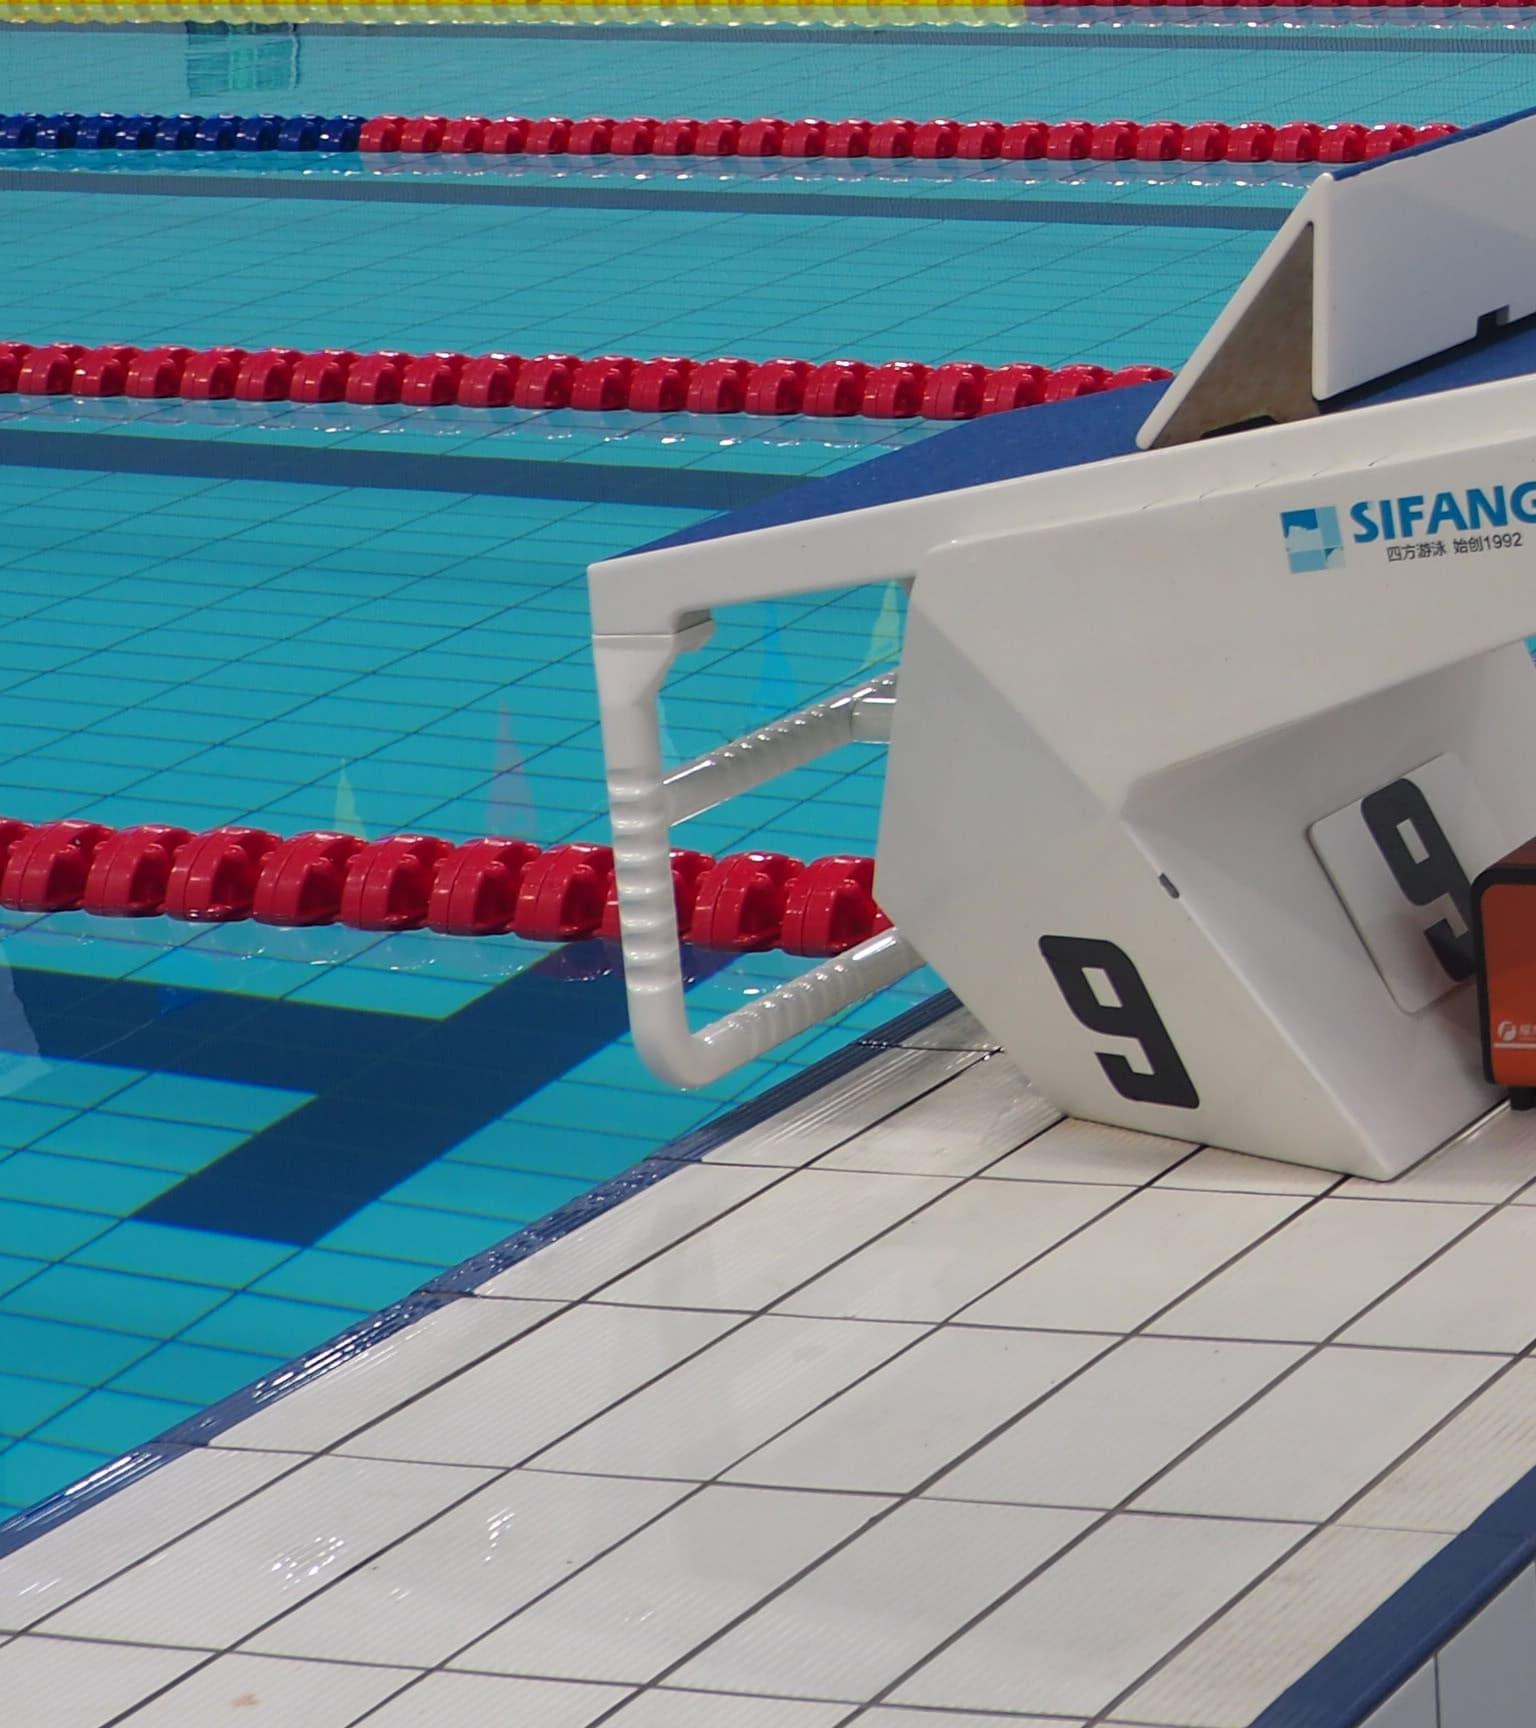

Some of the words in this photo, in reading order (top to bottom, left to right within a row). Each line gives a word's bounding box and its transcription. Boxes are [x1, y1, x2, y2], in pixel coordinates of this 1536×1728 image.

[1386, 540, 1447, 562] 四方游泳
[1453, 532, 1523, 555] 始创1992
[1361, 778, 1475, 982] 9
[1039, 934, 1200, 1109] 9
